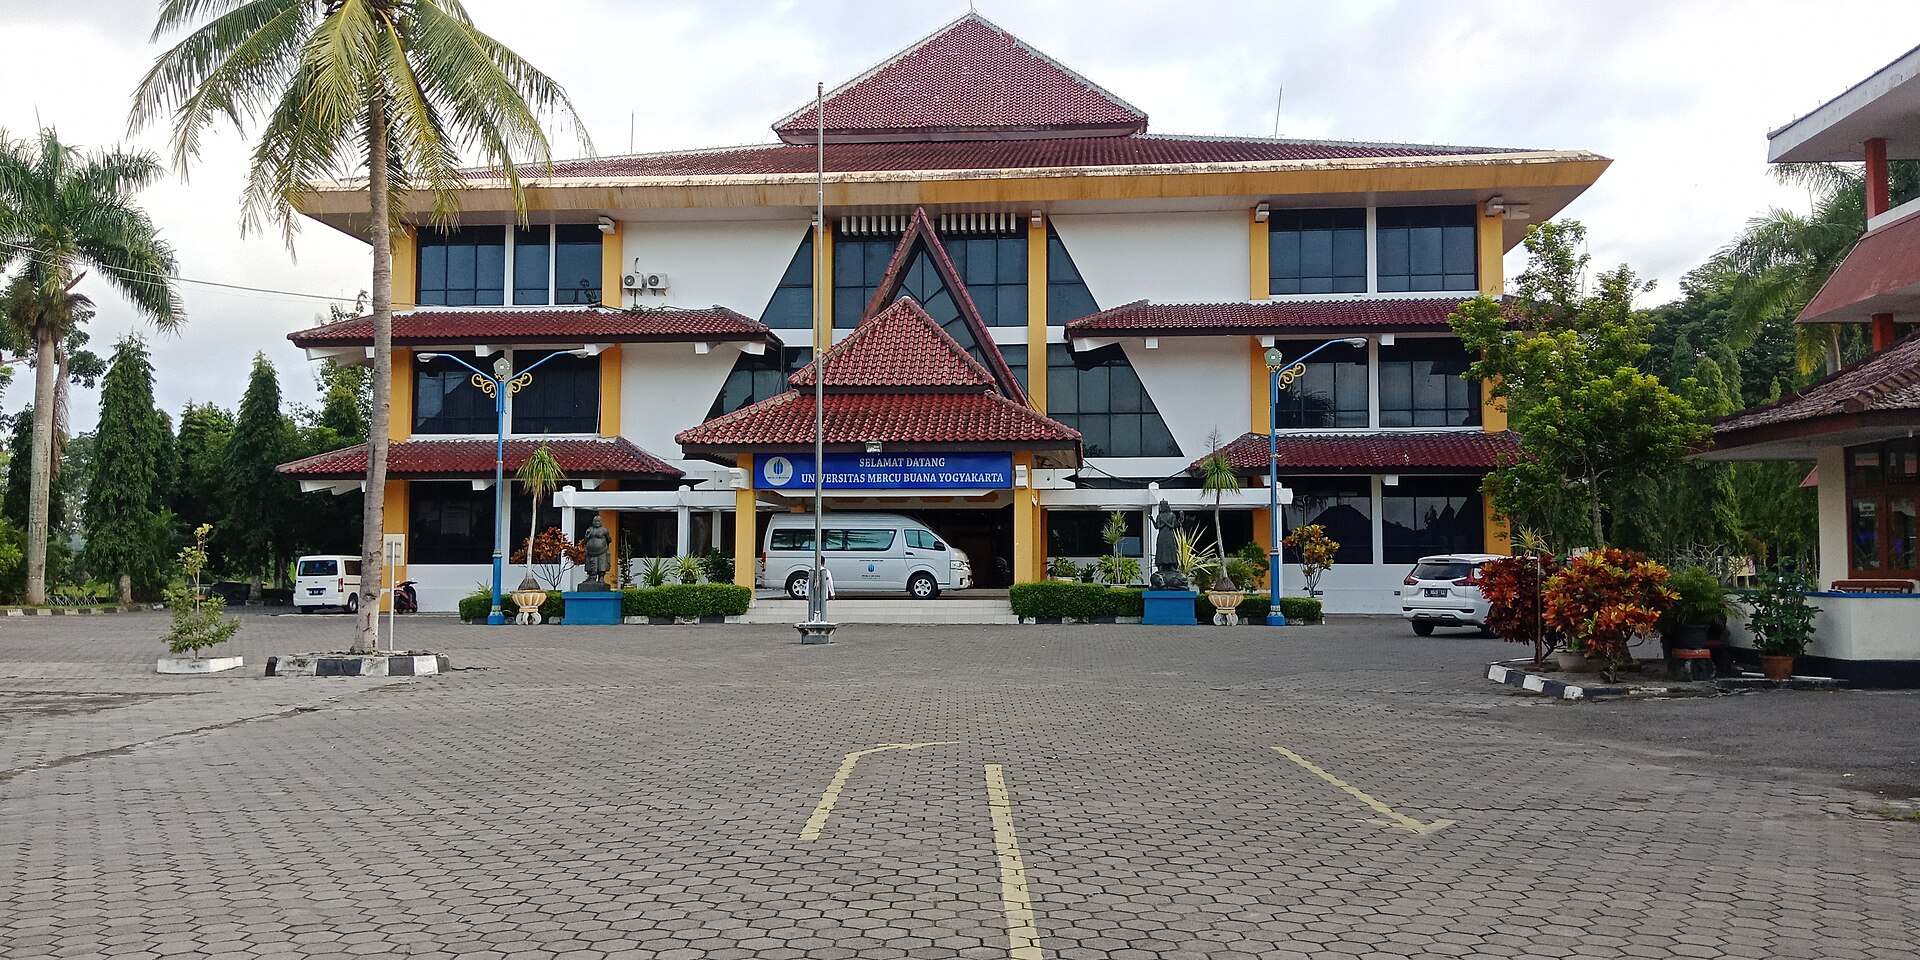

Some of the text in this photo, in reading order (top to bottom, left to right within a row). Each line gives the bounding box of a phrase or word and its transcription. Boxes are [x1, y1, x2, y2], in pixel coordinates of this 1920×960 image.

[859, 457, 946, 468] SELAMAT DATANG
[801, 472, 1004, 483] UNVERSITAS MERCU BUANA YOGYAKARTA
